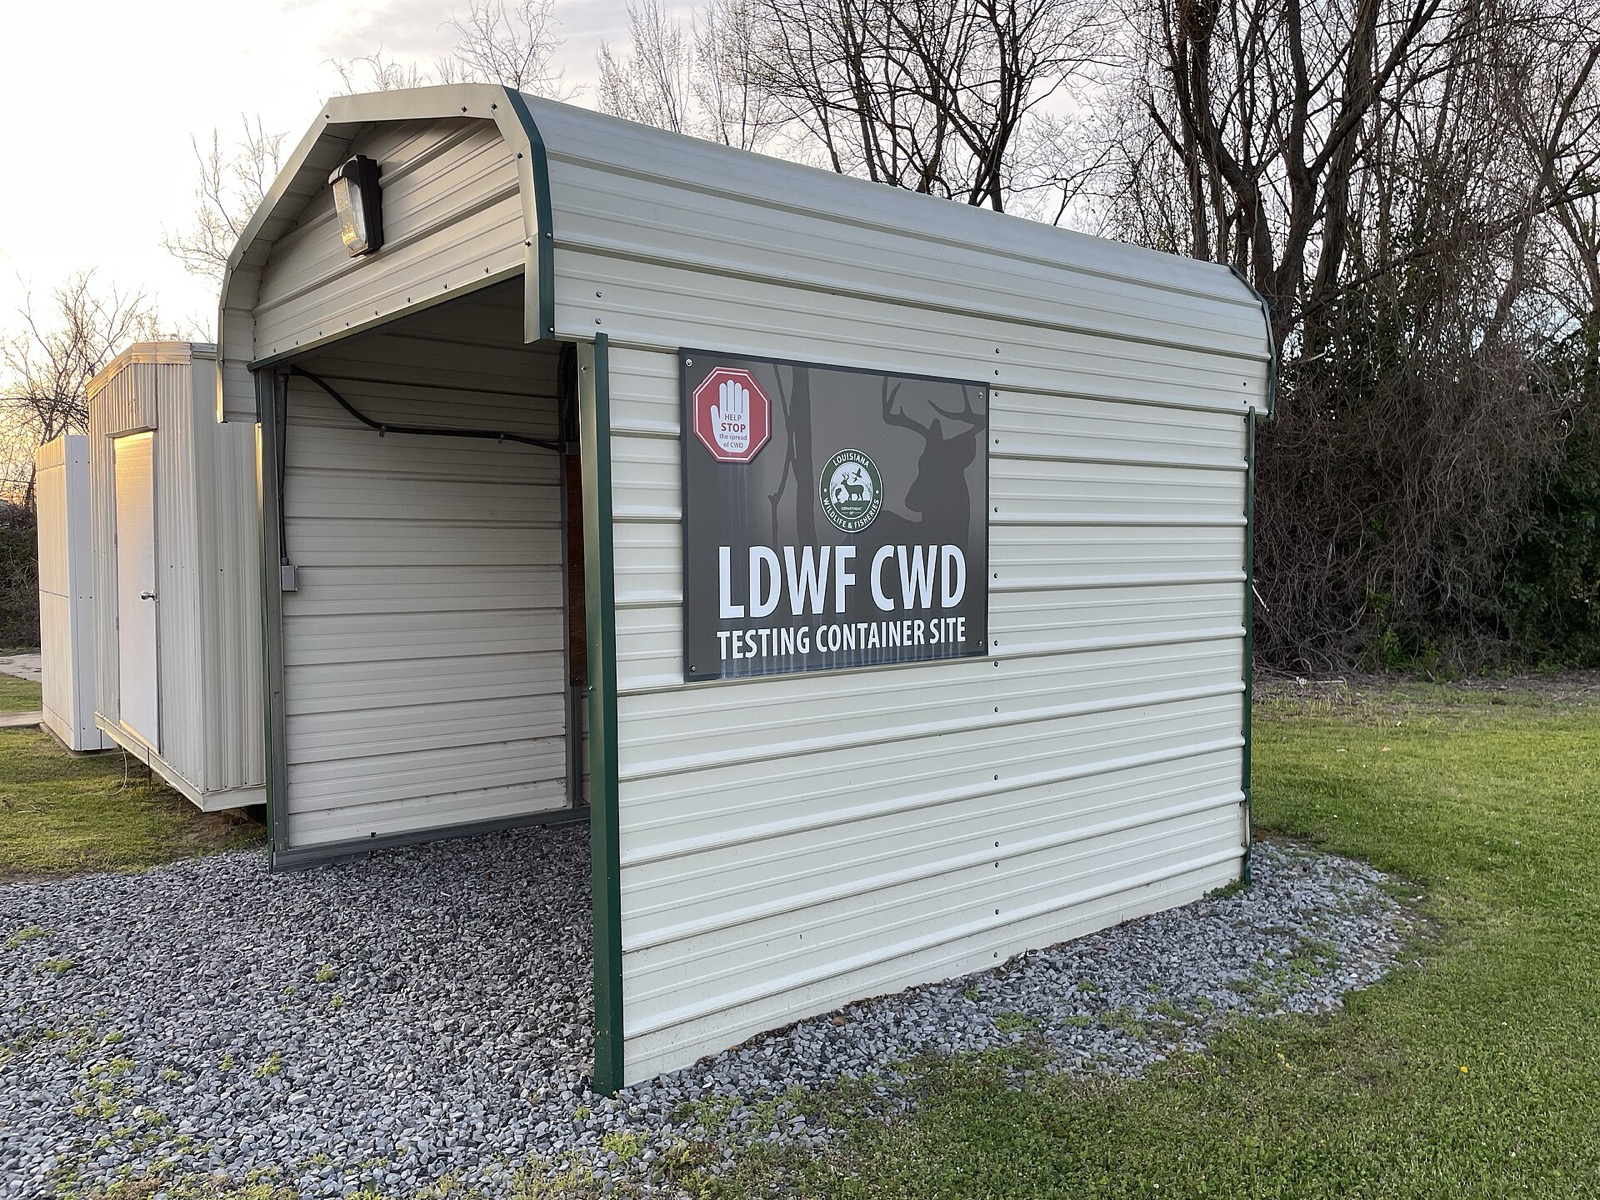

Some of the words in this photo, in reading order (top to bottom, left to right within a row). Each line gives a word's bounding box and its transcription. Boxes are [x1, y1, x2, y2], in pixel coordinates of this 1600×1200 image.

[721, 423, 746, 432] STOP
[832, 452, 869, 468] LOUISIANA
[823, 498, 846, 528] WILDLIFE
[854, 499, 879, 528] FISHERIES
[719, 546, 856, 619] LDWF
[870, 544, 966, 612] CWD
[717, 626, 810, 660] TESTING
[816, 619, 925, 652] CONTAINER
[930, 616, 966, 644] SITE
